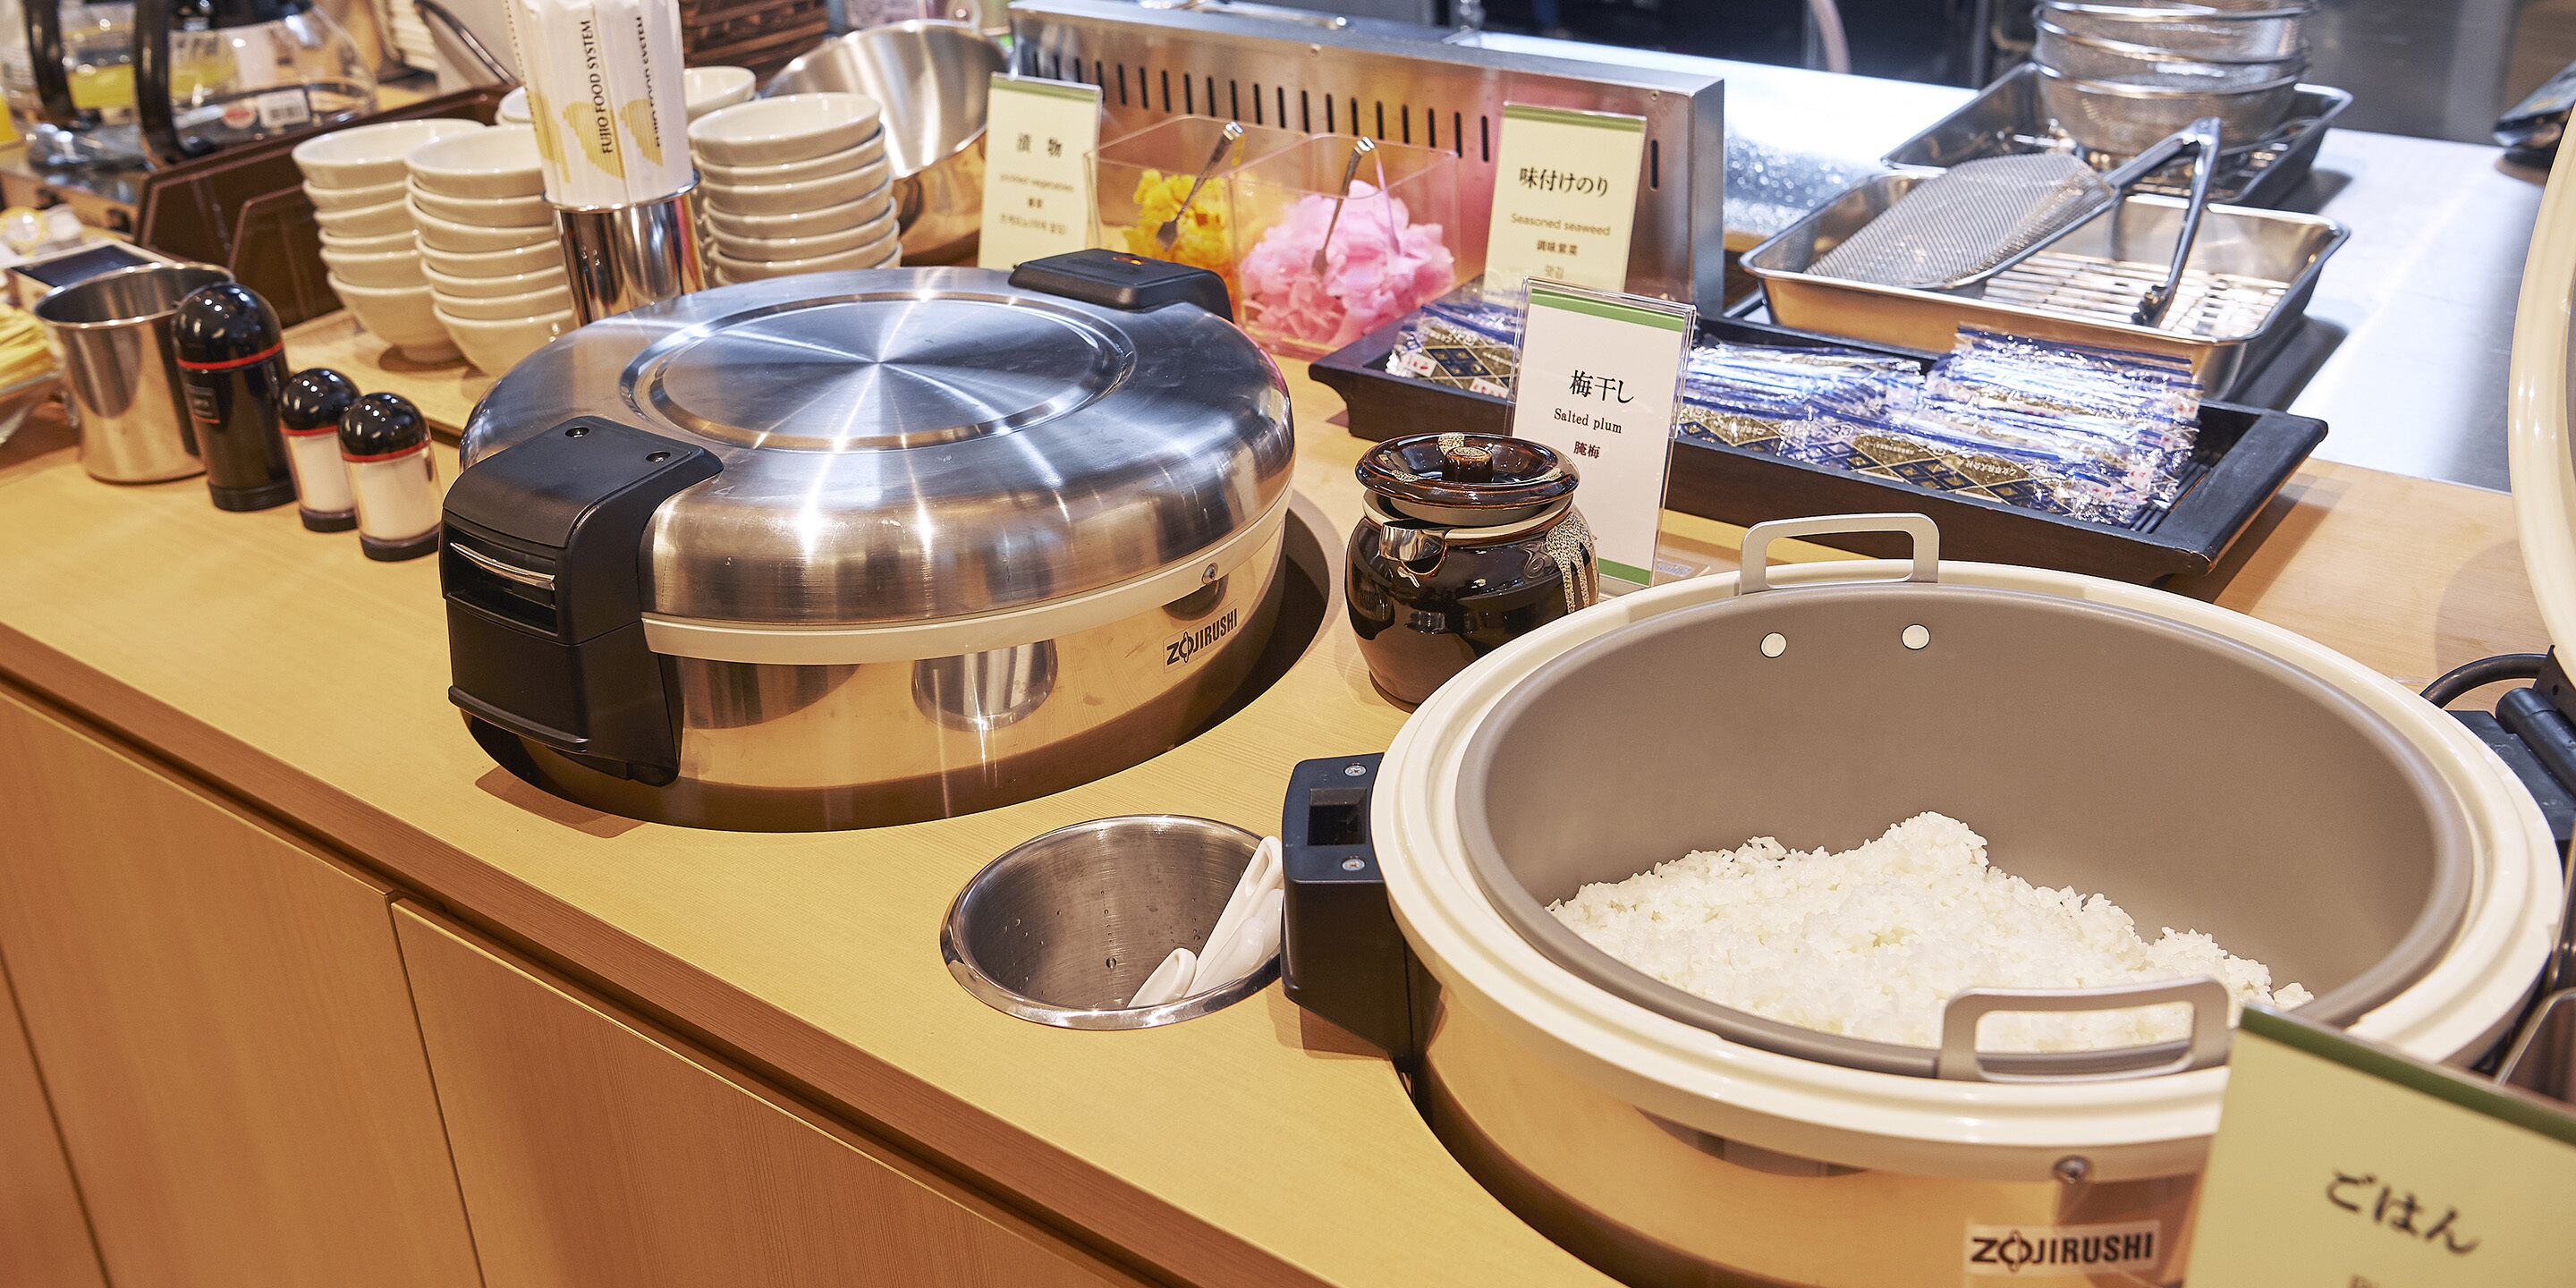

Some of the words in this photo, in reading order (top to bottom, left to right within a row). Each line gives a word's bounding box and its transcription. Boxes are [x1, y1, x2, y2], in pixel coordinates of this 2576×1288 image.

[580, 20, 599, 69] SYSTEM
[589, 72, 606, 113] FOOD
[597, 116, 613, 154] FUJIO
[1519, 166, 1608, 198] 味付けのり
[1512, 212, 1561, 229] Seasoned
[1563, 222, 1611, 236] seaweed
[1569, 369, 1634, 403] 梅干し
[1554, 407, 1589, 426] Salted
[1592, 417, 1622, 434] plum
[1166, 608, 1238, 665] ZOJIRUSHI
[2326, 1169, 2481, 1255] ごはん
[1970, 1229, 2153, 1273] ZOJIRUSHI
